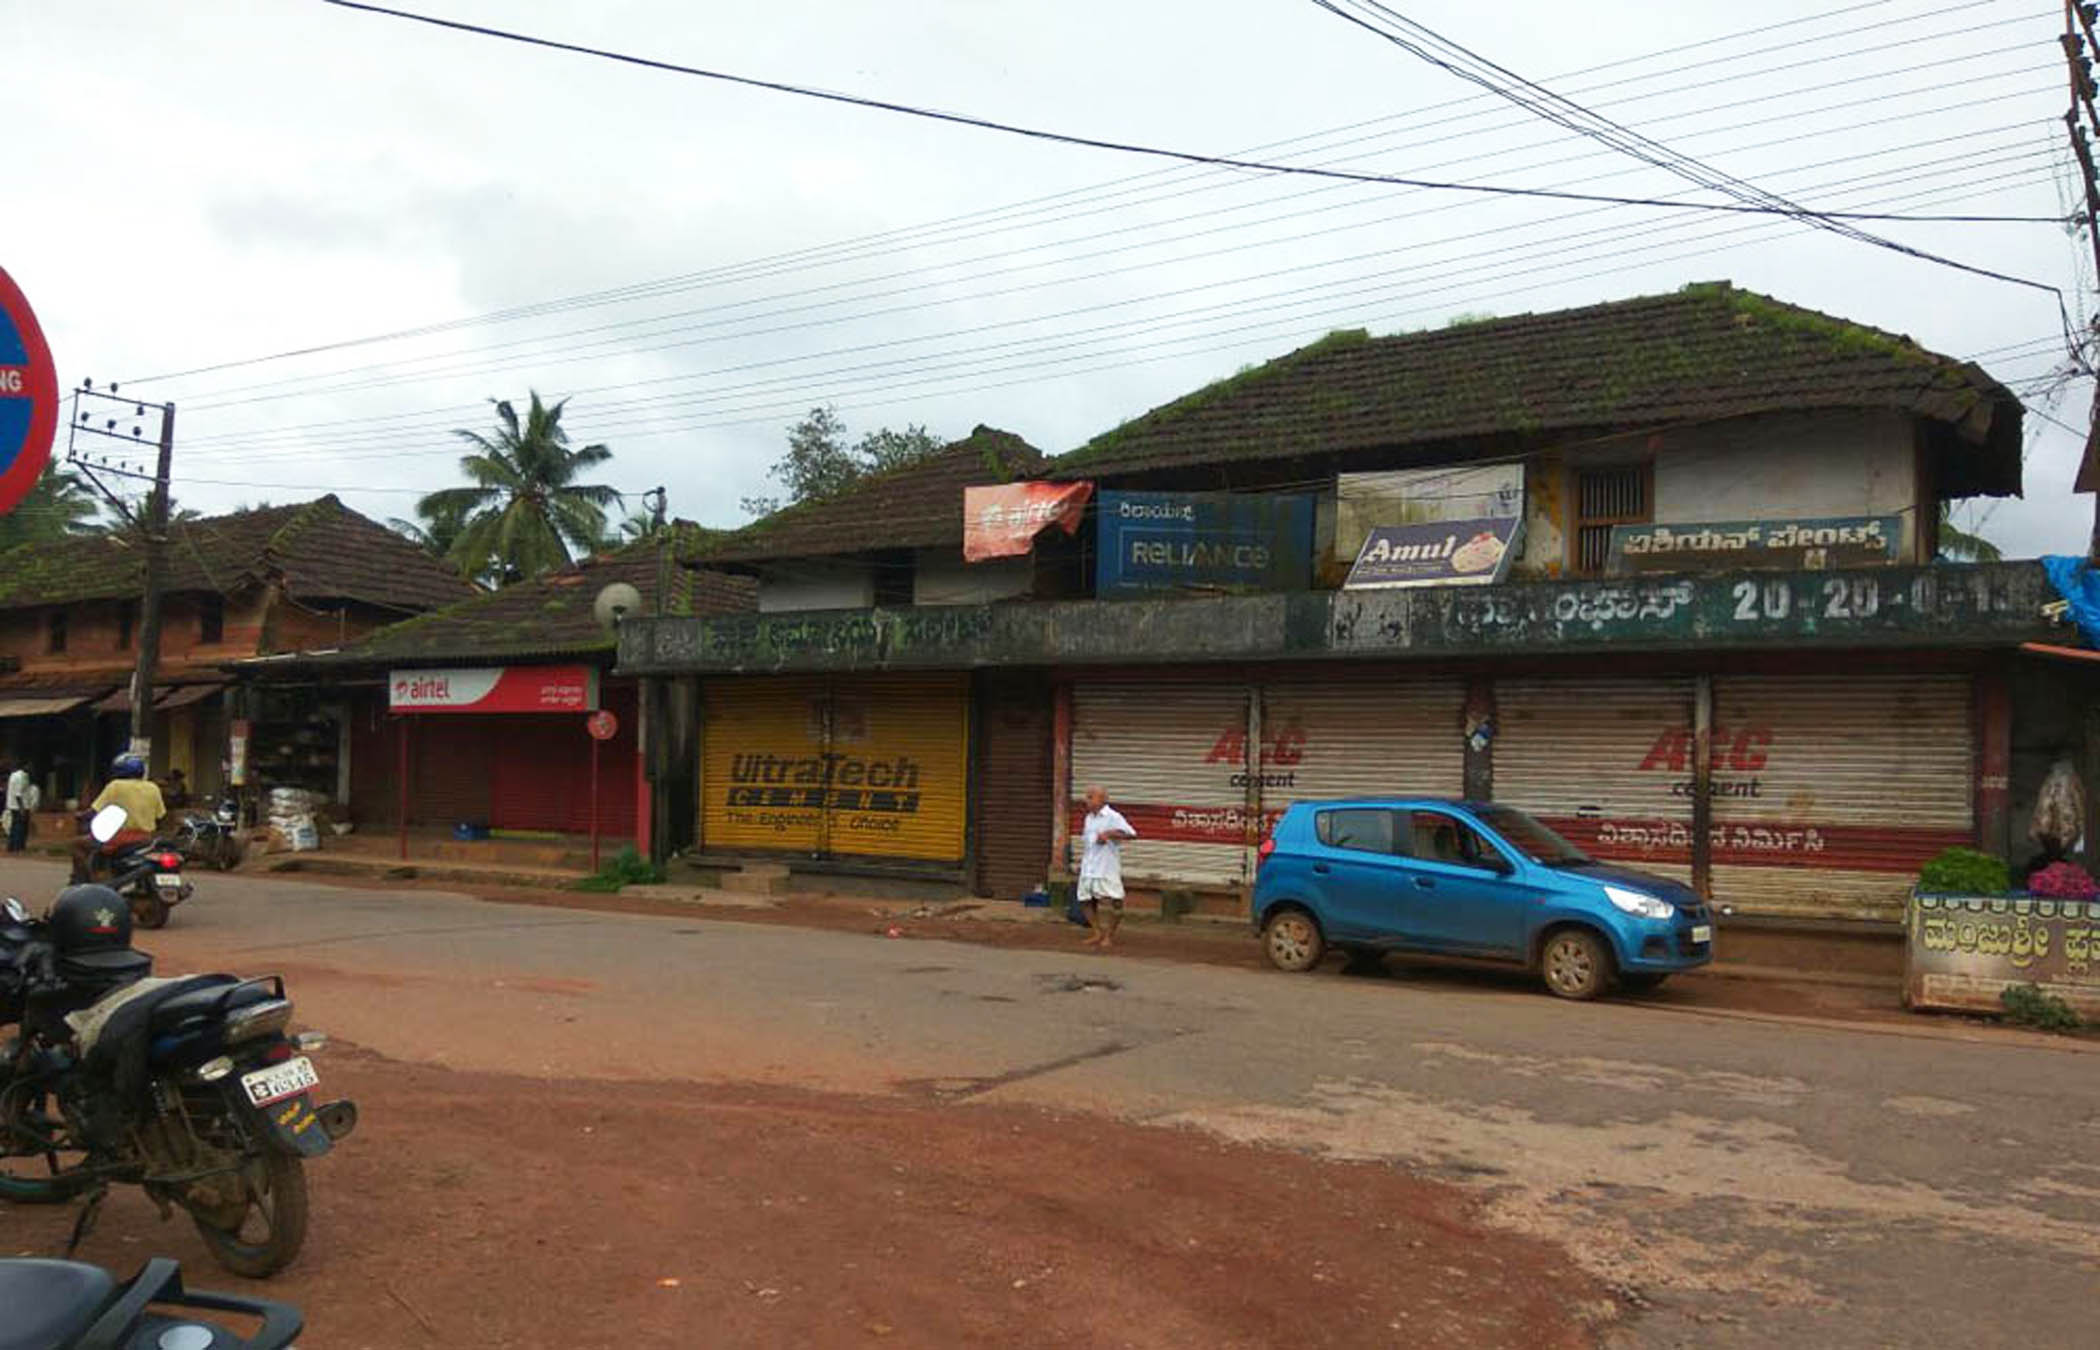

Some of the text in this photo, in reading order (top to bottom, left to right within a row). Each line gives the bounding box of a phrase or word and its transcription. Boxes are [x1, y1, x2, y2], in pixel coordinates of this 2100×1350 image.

[1361, 534, 1457, 562] Amul
[410, 674, 449, 699] airtel
[731, 754, 919, 788] UltraTech
